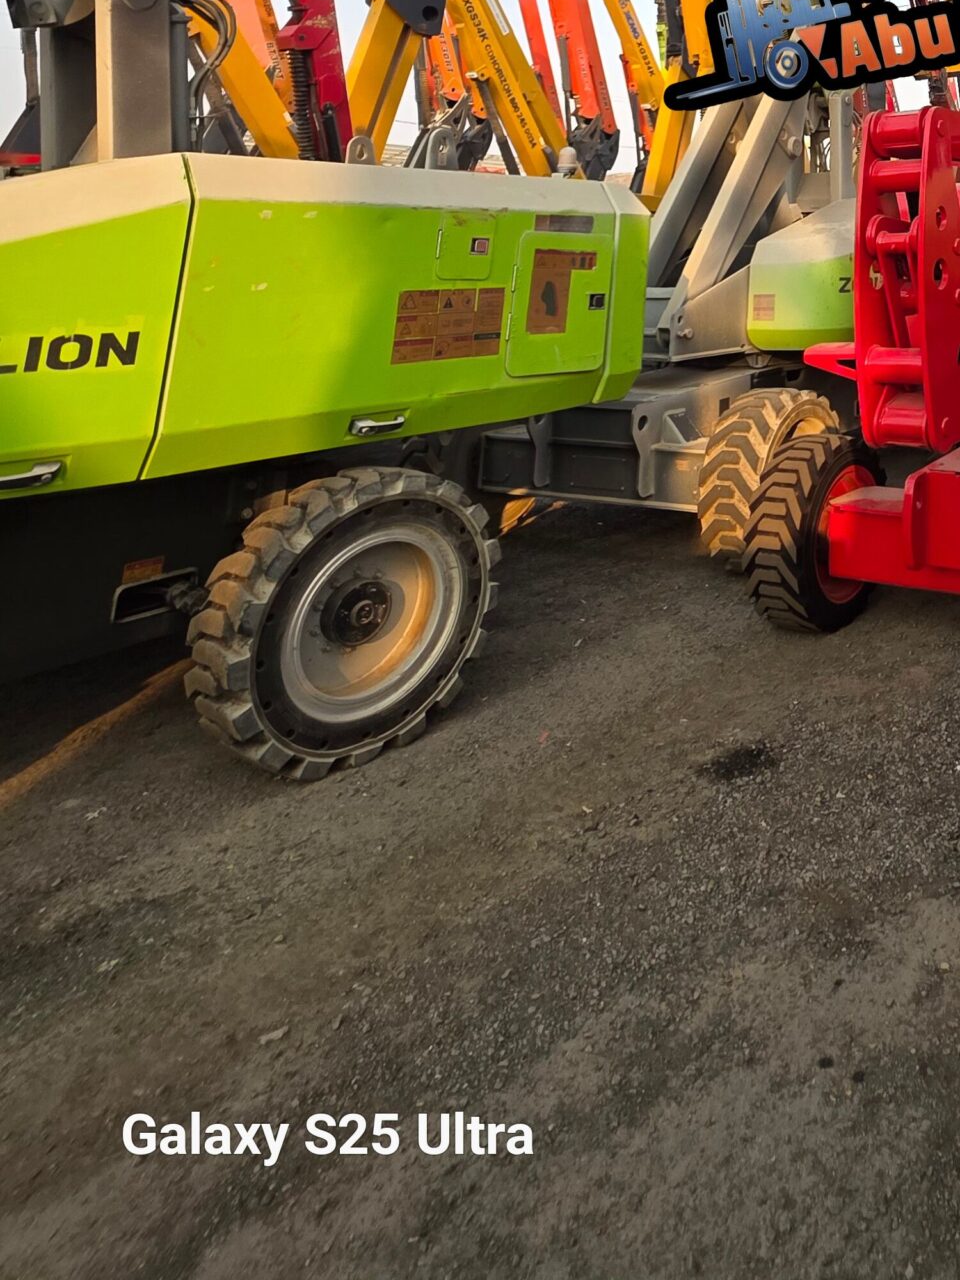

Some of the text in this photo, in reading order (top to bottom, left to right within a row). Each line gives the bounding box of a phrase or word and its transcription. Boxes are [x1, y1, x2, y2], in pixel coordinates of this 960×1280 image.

[462, 0, 489, 43] XGS34K
[485, 44, 513, 100] CDHORIZON
[624, 10, 654, 77] XCMG XGS34K
